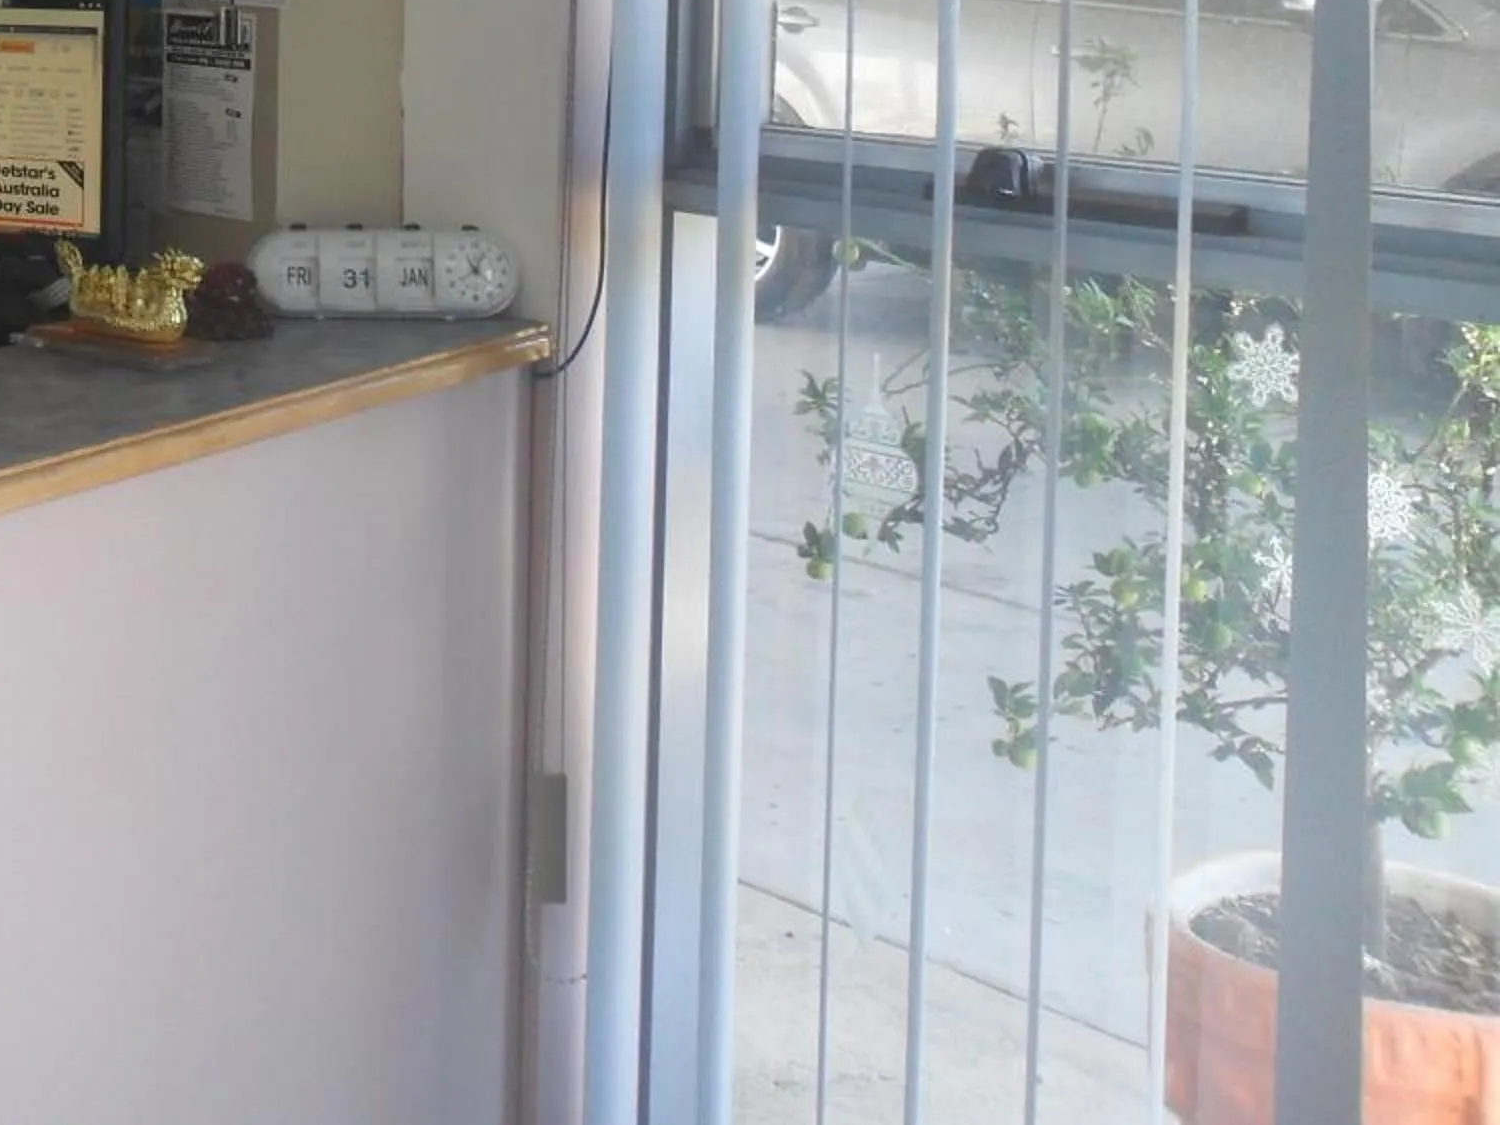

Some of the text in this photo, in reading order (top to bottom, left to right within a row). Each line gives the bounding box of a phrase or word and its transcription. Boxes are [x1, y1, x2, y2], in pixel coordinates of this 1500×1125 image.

[26, 200, 60, 216] Sale
[287, 266, 429, 289] FRI 31 JAN
